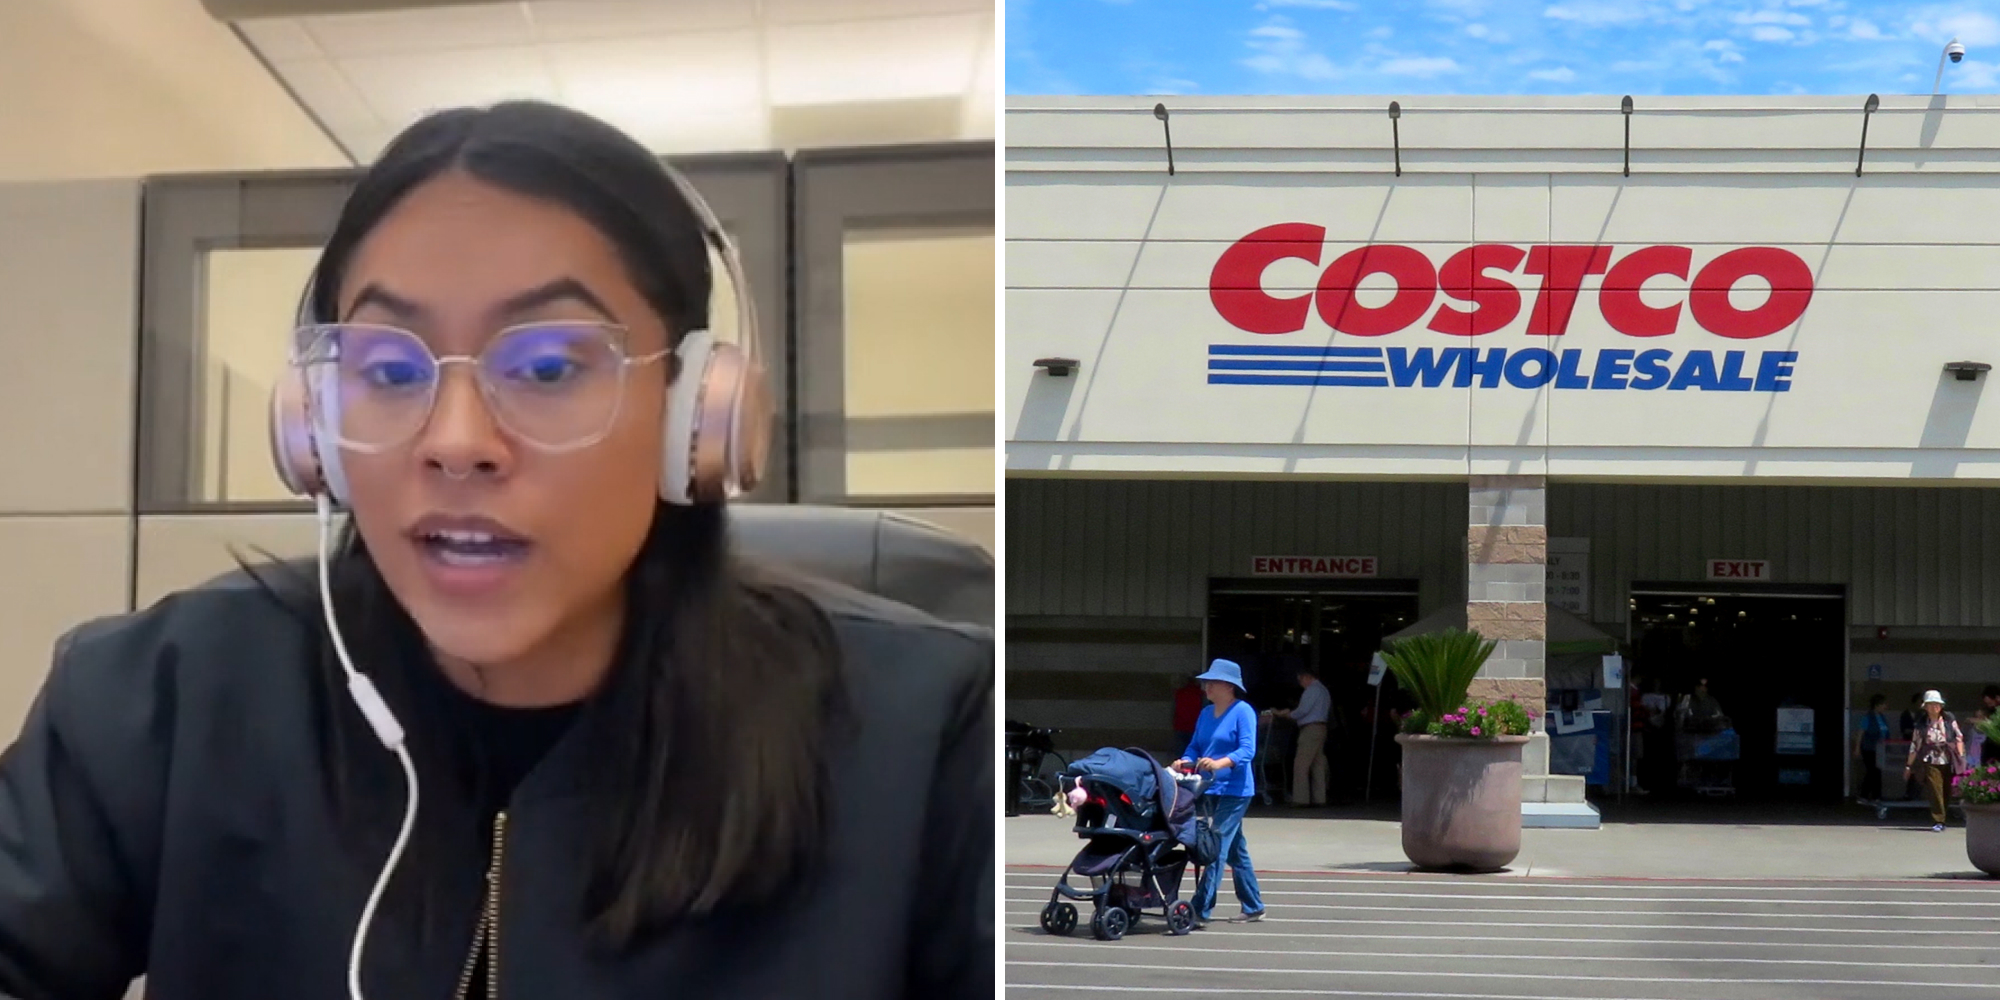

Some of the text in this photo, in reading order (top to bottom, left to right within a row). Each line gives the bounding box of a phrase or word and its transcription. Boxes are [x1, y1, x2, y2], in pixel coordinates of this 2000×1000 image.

[1209, 222, 1814, 338] COSTCO
[1386, 346, 1799, 392] WHOLESALE
[1254, 557, 1374, 574] ENTRANCE
[1713, 561, 1765, 578] EXIT
